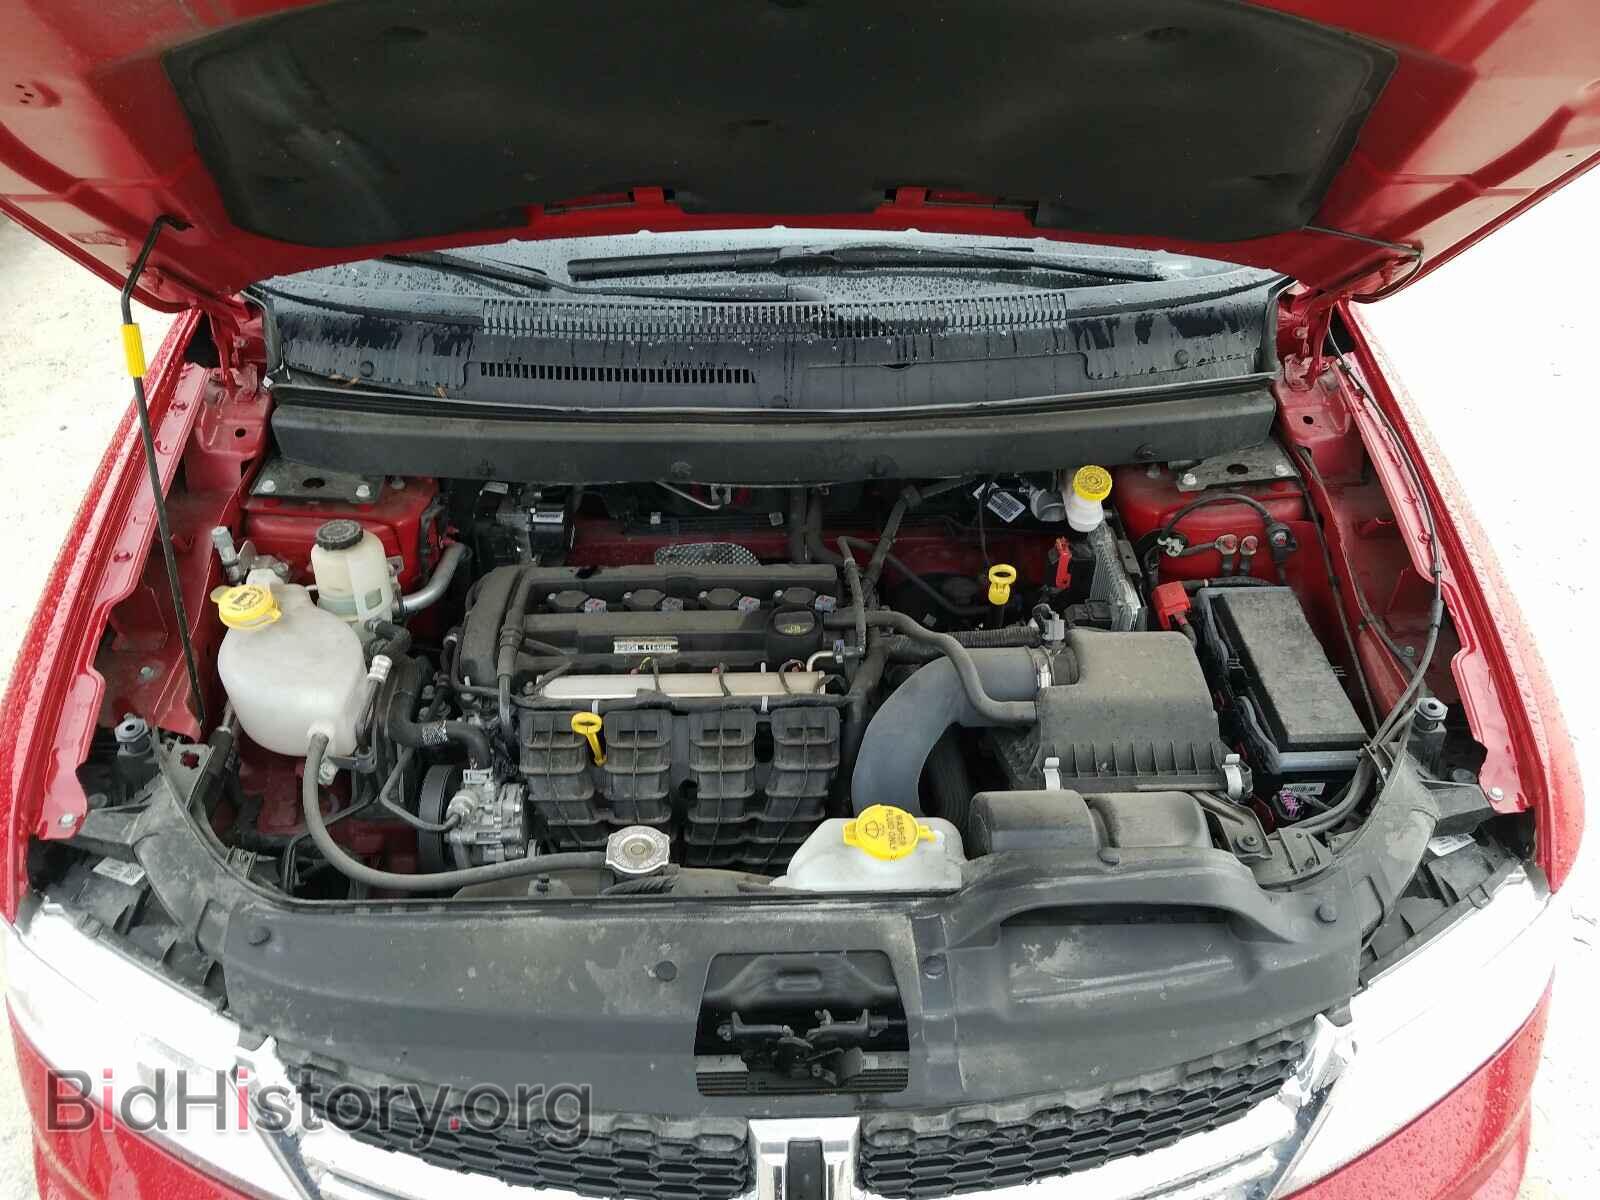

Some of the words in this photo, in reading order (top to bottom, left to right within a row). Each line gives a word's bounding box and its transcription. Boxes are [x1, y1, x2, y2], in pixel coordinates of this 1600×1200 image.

[886, 808, 895, 829] FLUID
[889, 831, 897, 850] ONLY
[896, 814, 906, 846] WASHER
